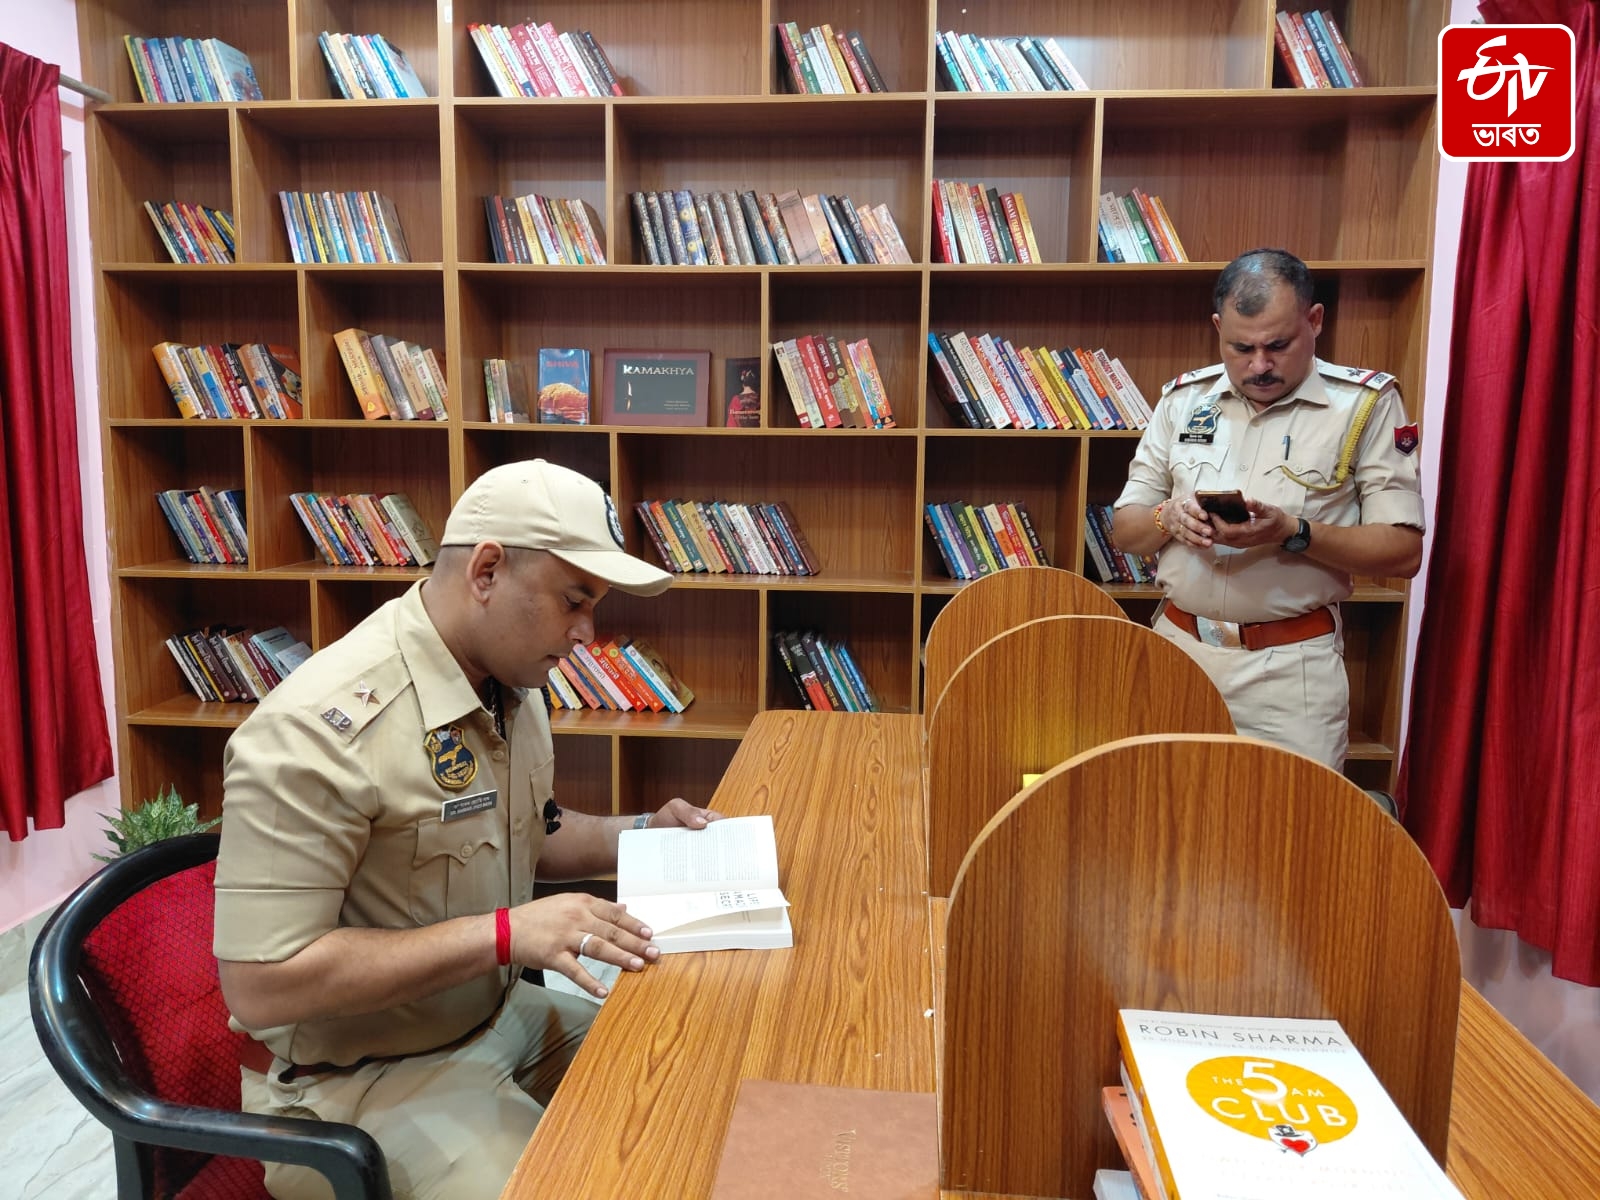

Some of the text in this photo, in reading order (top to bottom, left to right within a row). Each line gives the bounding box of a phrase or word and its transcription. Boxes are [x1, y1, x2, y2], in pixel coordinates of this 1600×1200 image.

[976, 209, 997, 259] THE AHOMS
[623, 364, 694, 376] KAMAKHYA
[958, 336, 991, 390] GENERAL STUDIES
[1095, 350, 1123, 391] PEDAGOGY MASTER
[1139, 1024, 1219, 1040] ROBIN
[1233, 1031, 1343, 1047] SHARMA
[1212, 1075, 1325, 1099] THE AM
[1241, 1061, 1287, 1100] 5
[1211, 1096, 1348, 1127] CLUB
